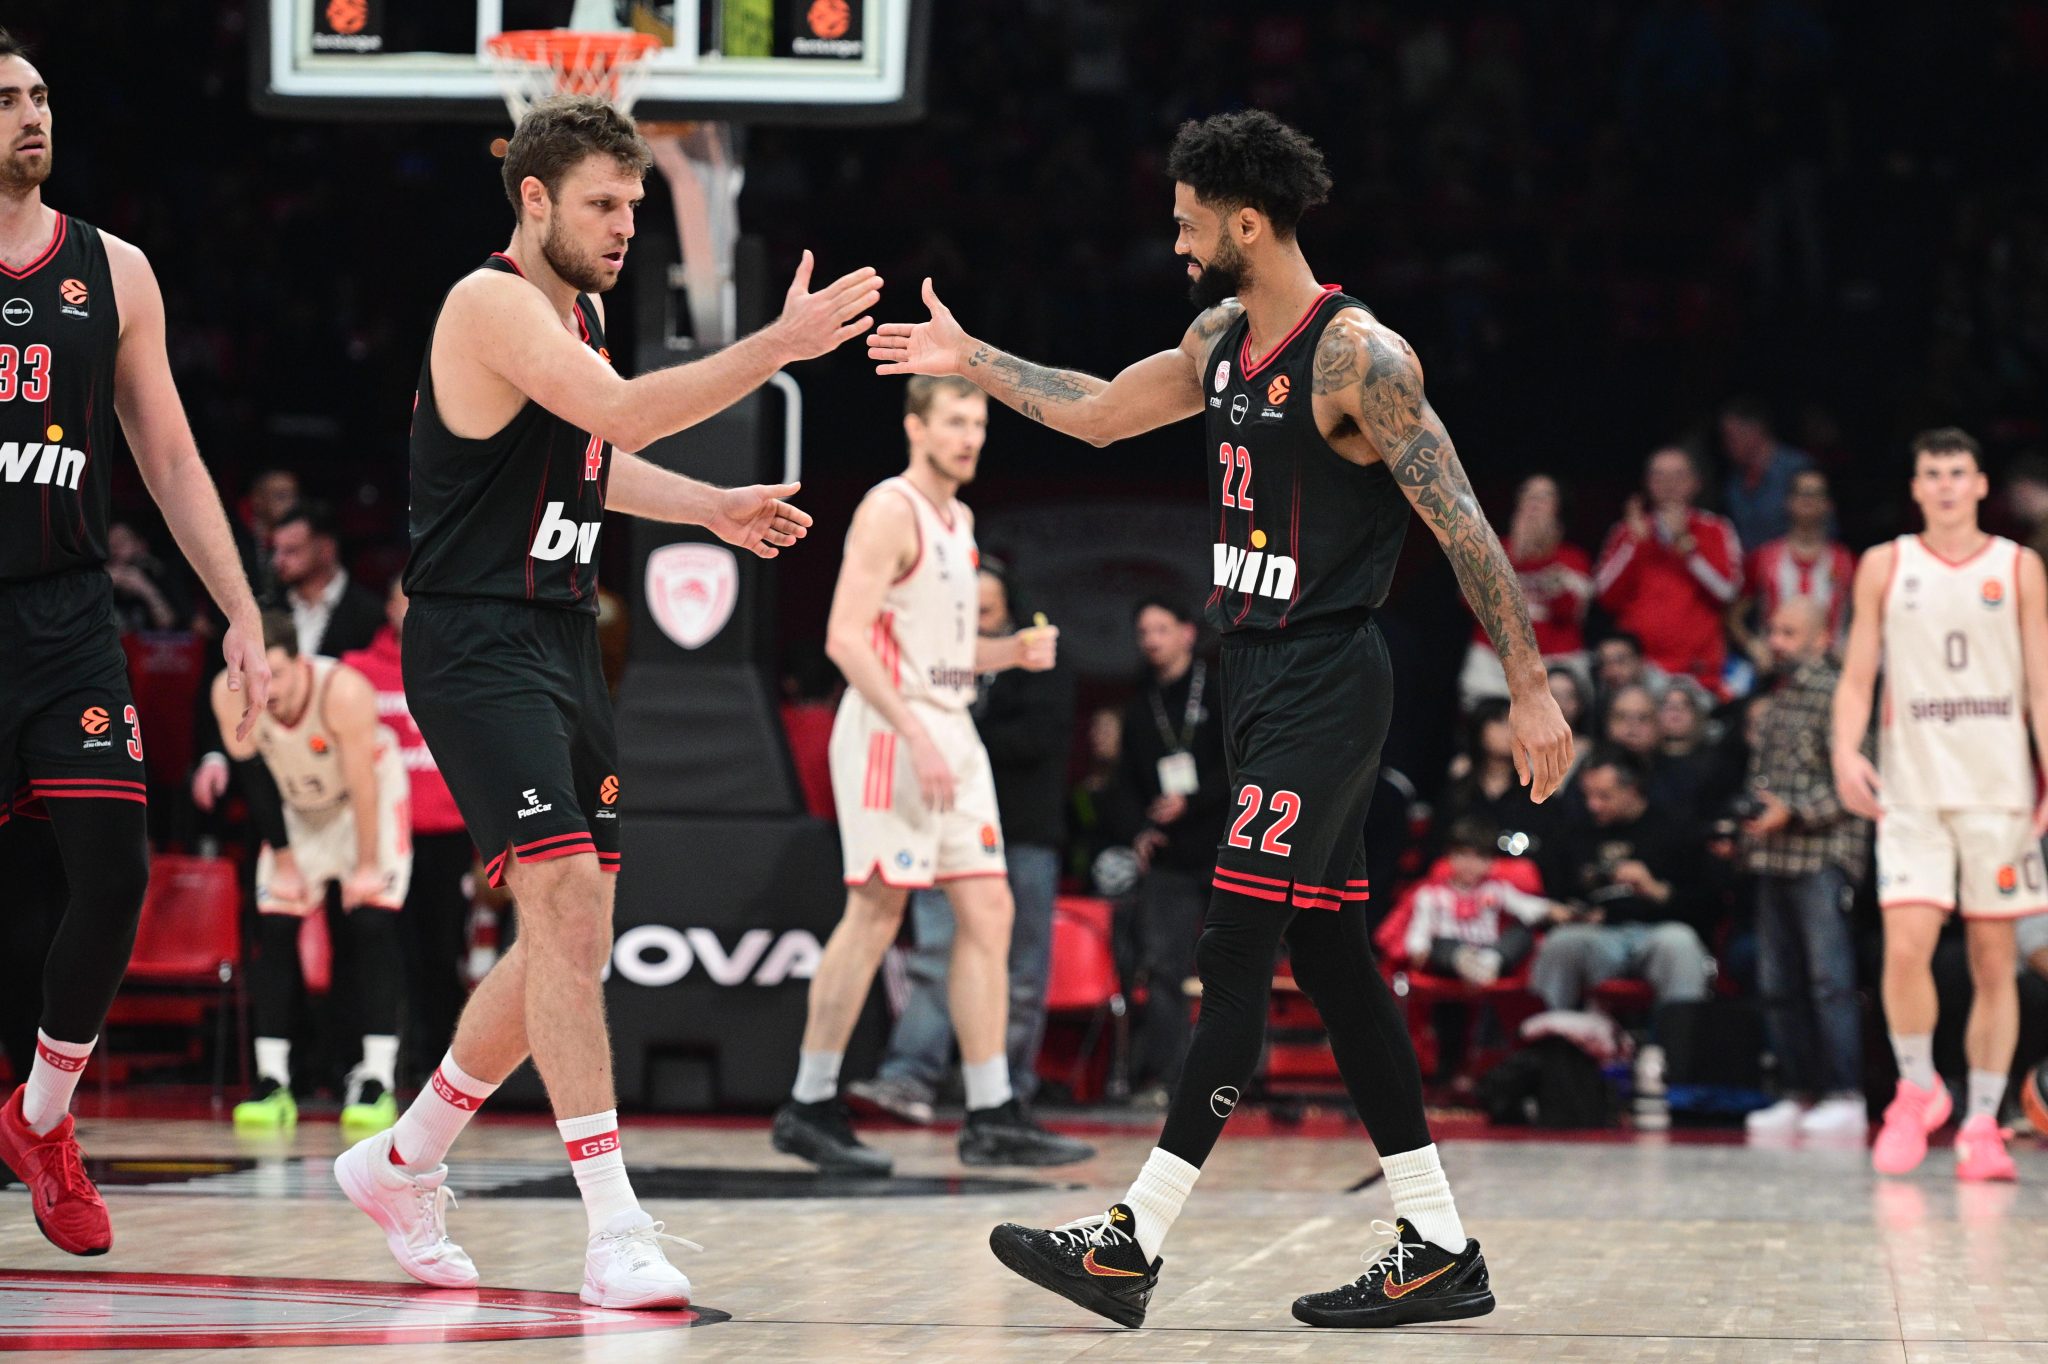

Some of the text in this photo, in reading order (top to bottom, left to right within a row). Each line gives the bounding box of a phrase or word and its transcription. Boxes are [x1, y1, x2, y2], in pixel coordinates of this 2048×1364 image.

[1219, 442, 1254, 511] 22
[1405, 447, 1437, 483] 210
[1946, 630, 1968, 672] 0
[517, 803, 552, 819] FlexCar
[1228, 784, 1301, 857] 22
[601, 924, 824, 986] OVA
[433, 1072, 471, 1110] GSA
